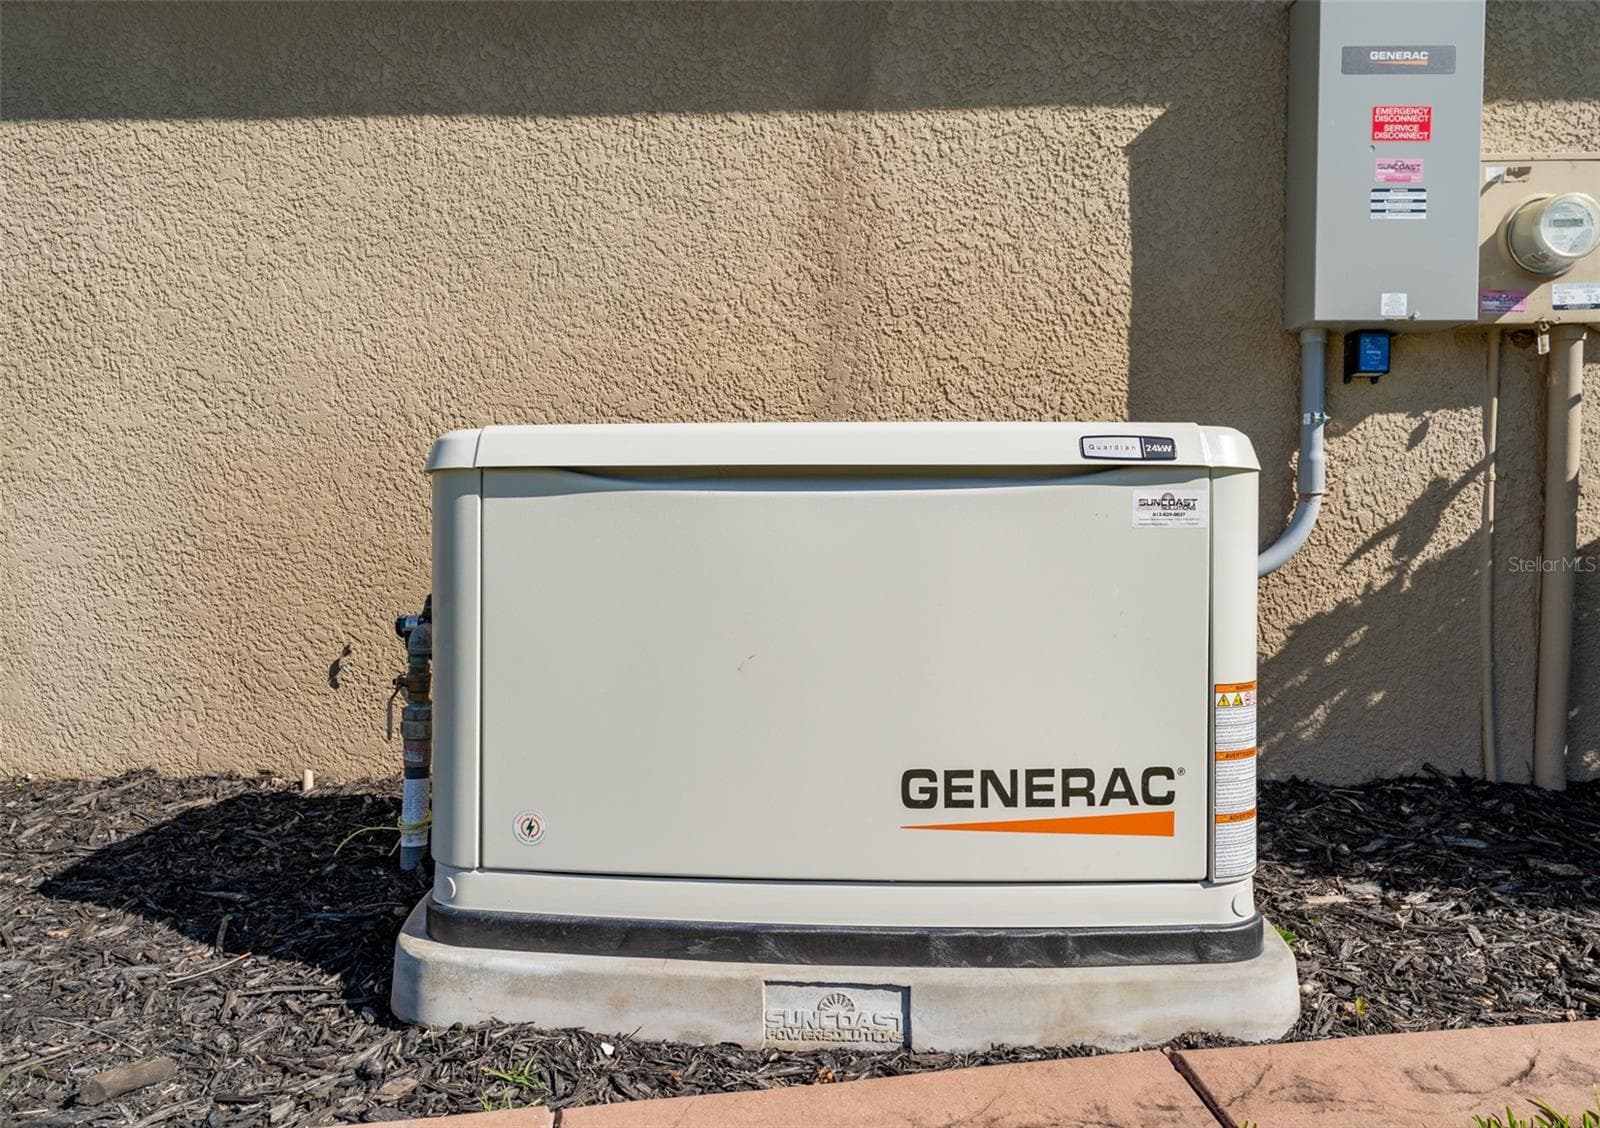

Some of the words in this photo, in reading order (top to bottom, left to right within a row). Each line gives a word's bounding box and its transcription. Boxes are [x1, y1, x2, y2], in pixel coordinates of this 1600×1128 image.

[1370, 51, 1428, 60] GENERAC
[1375, 107, 1429, 115] EMERGENCY
[1384, 124, 1420, 132] SERVICE
[1088, 443, 1136, 451] Guardian
[1145, 444, 1172, 453] 24kW
[1138, 498, 1198, 507] SUNCOAST
[765, 1008, 901, 1032] SUNCOAST
